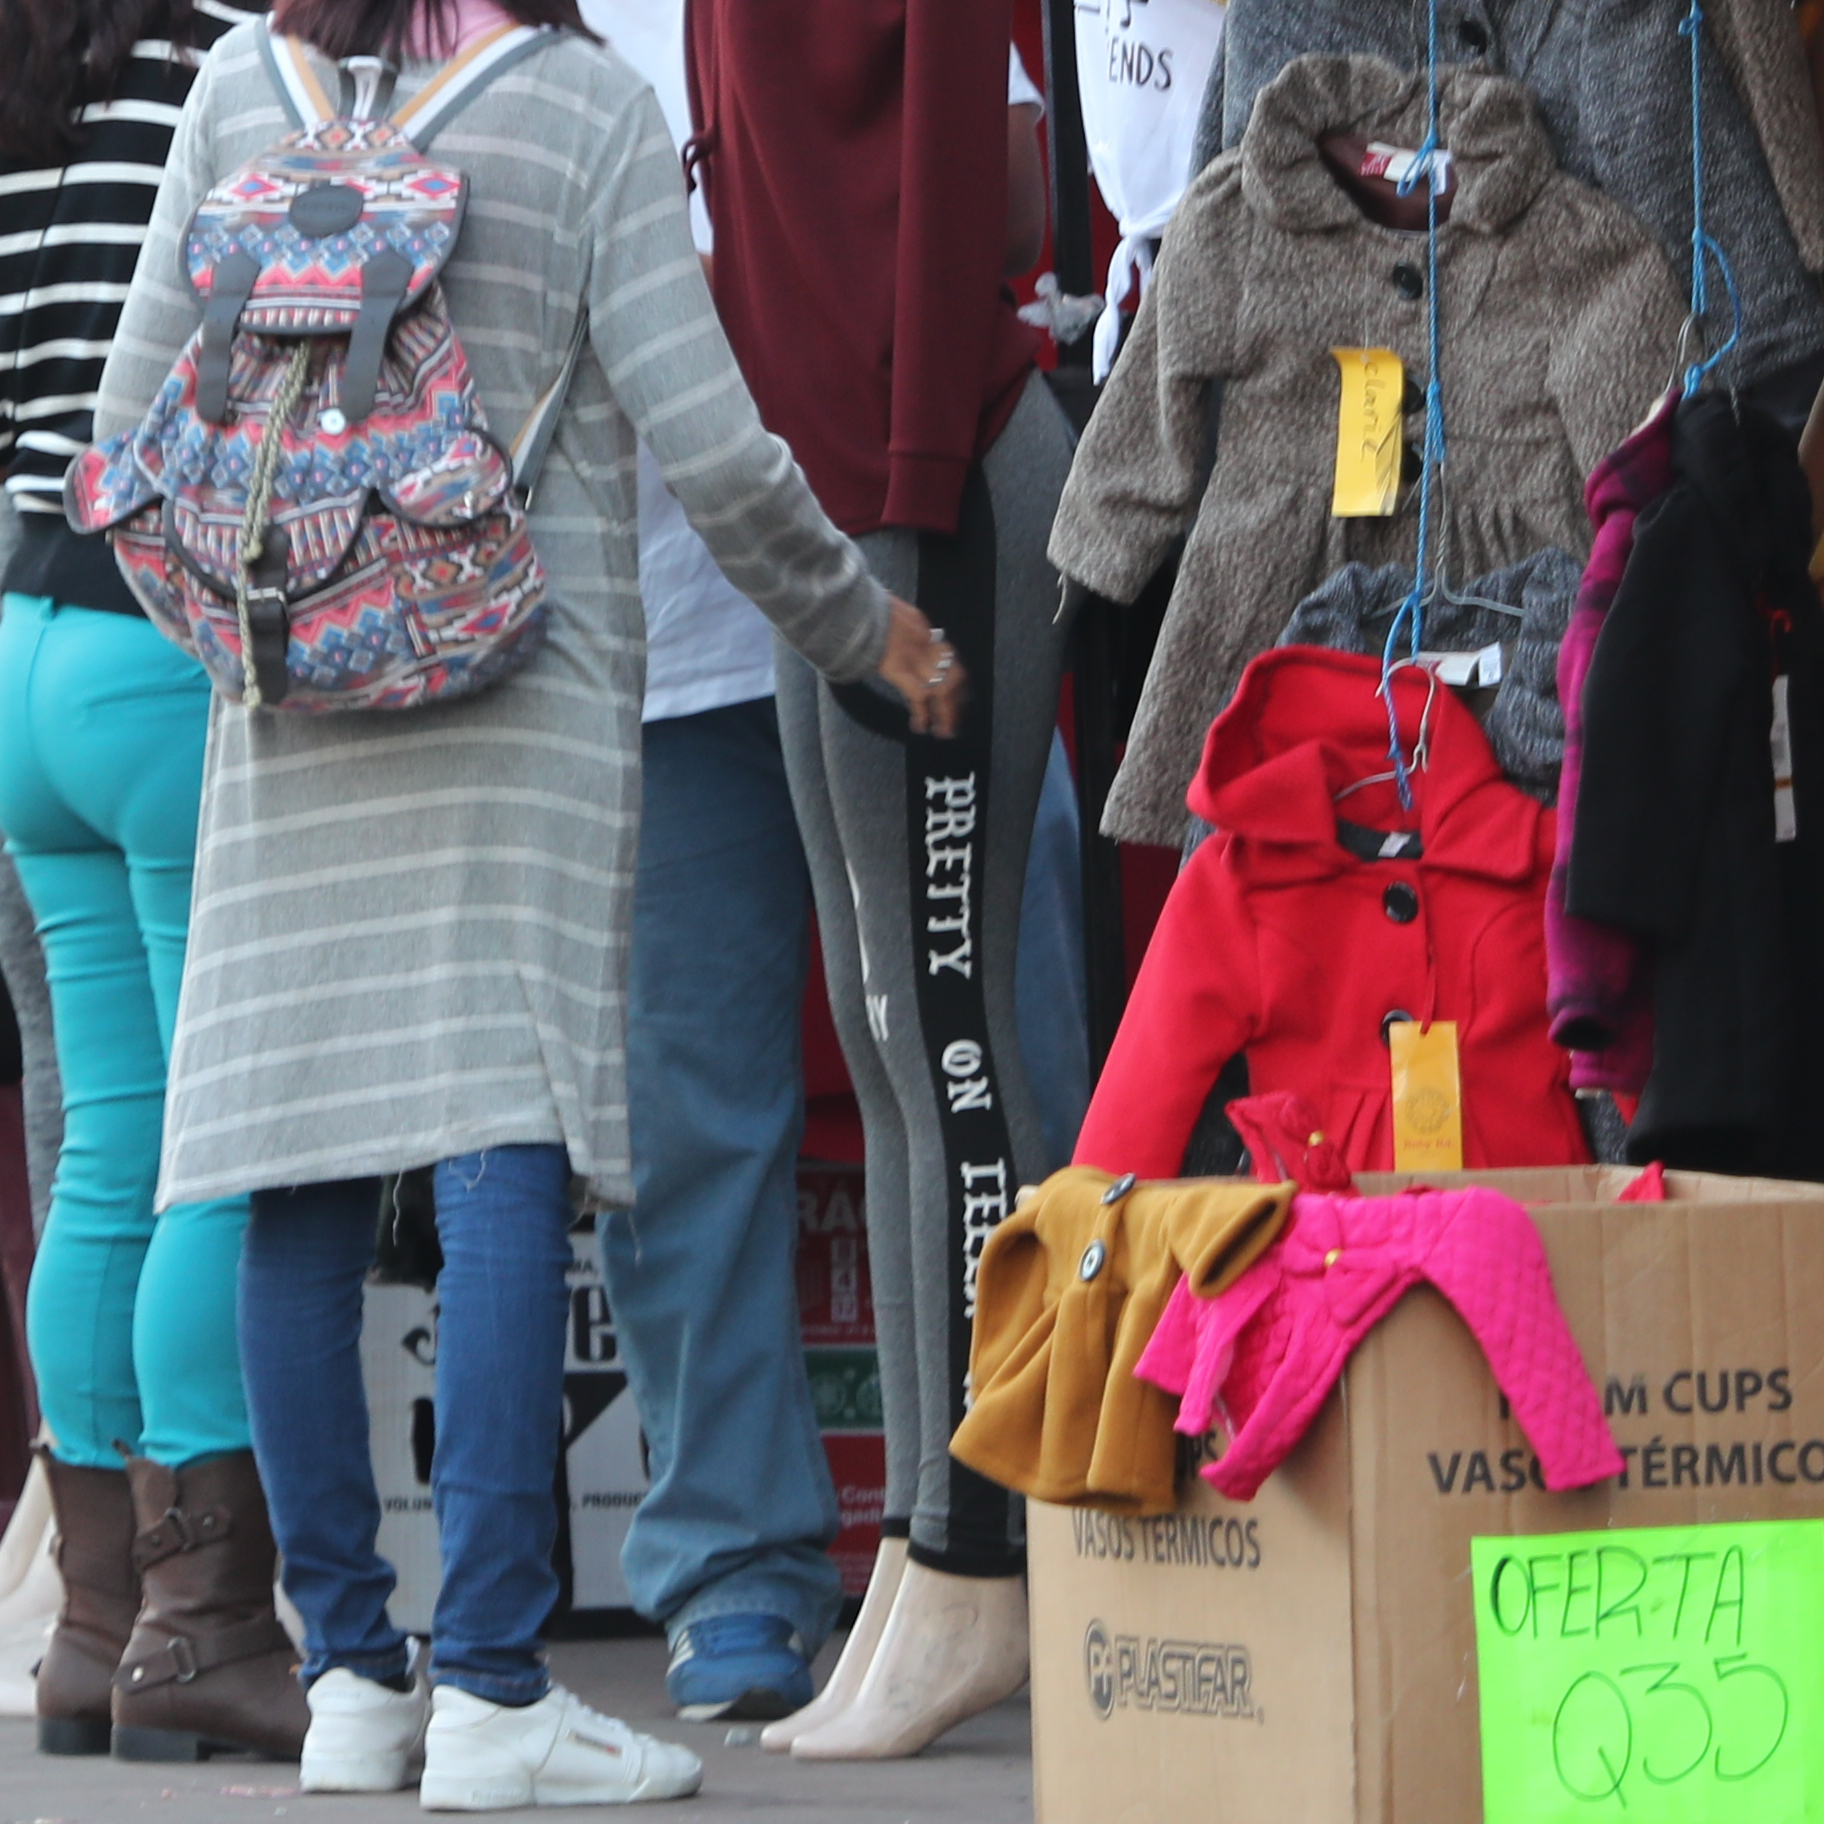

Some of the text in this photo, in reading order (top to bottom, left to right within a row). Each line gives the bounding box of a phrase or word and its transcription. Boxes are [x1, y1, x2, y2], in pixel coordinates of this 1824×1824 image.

[925, 772, 977, 980] PRETTY
[940, 1038, 994, 1115] ON
[1661, 1367, 1794, 1415] CUPS
[1488, 1543, 1747, 1647] OFERTA
[1114, 1633, 1258, 1721] PLASTIFAR
[1551, 1651, 1791, 1810] Q35
